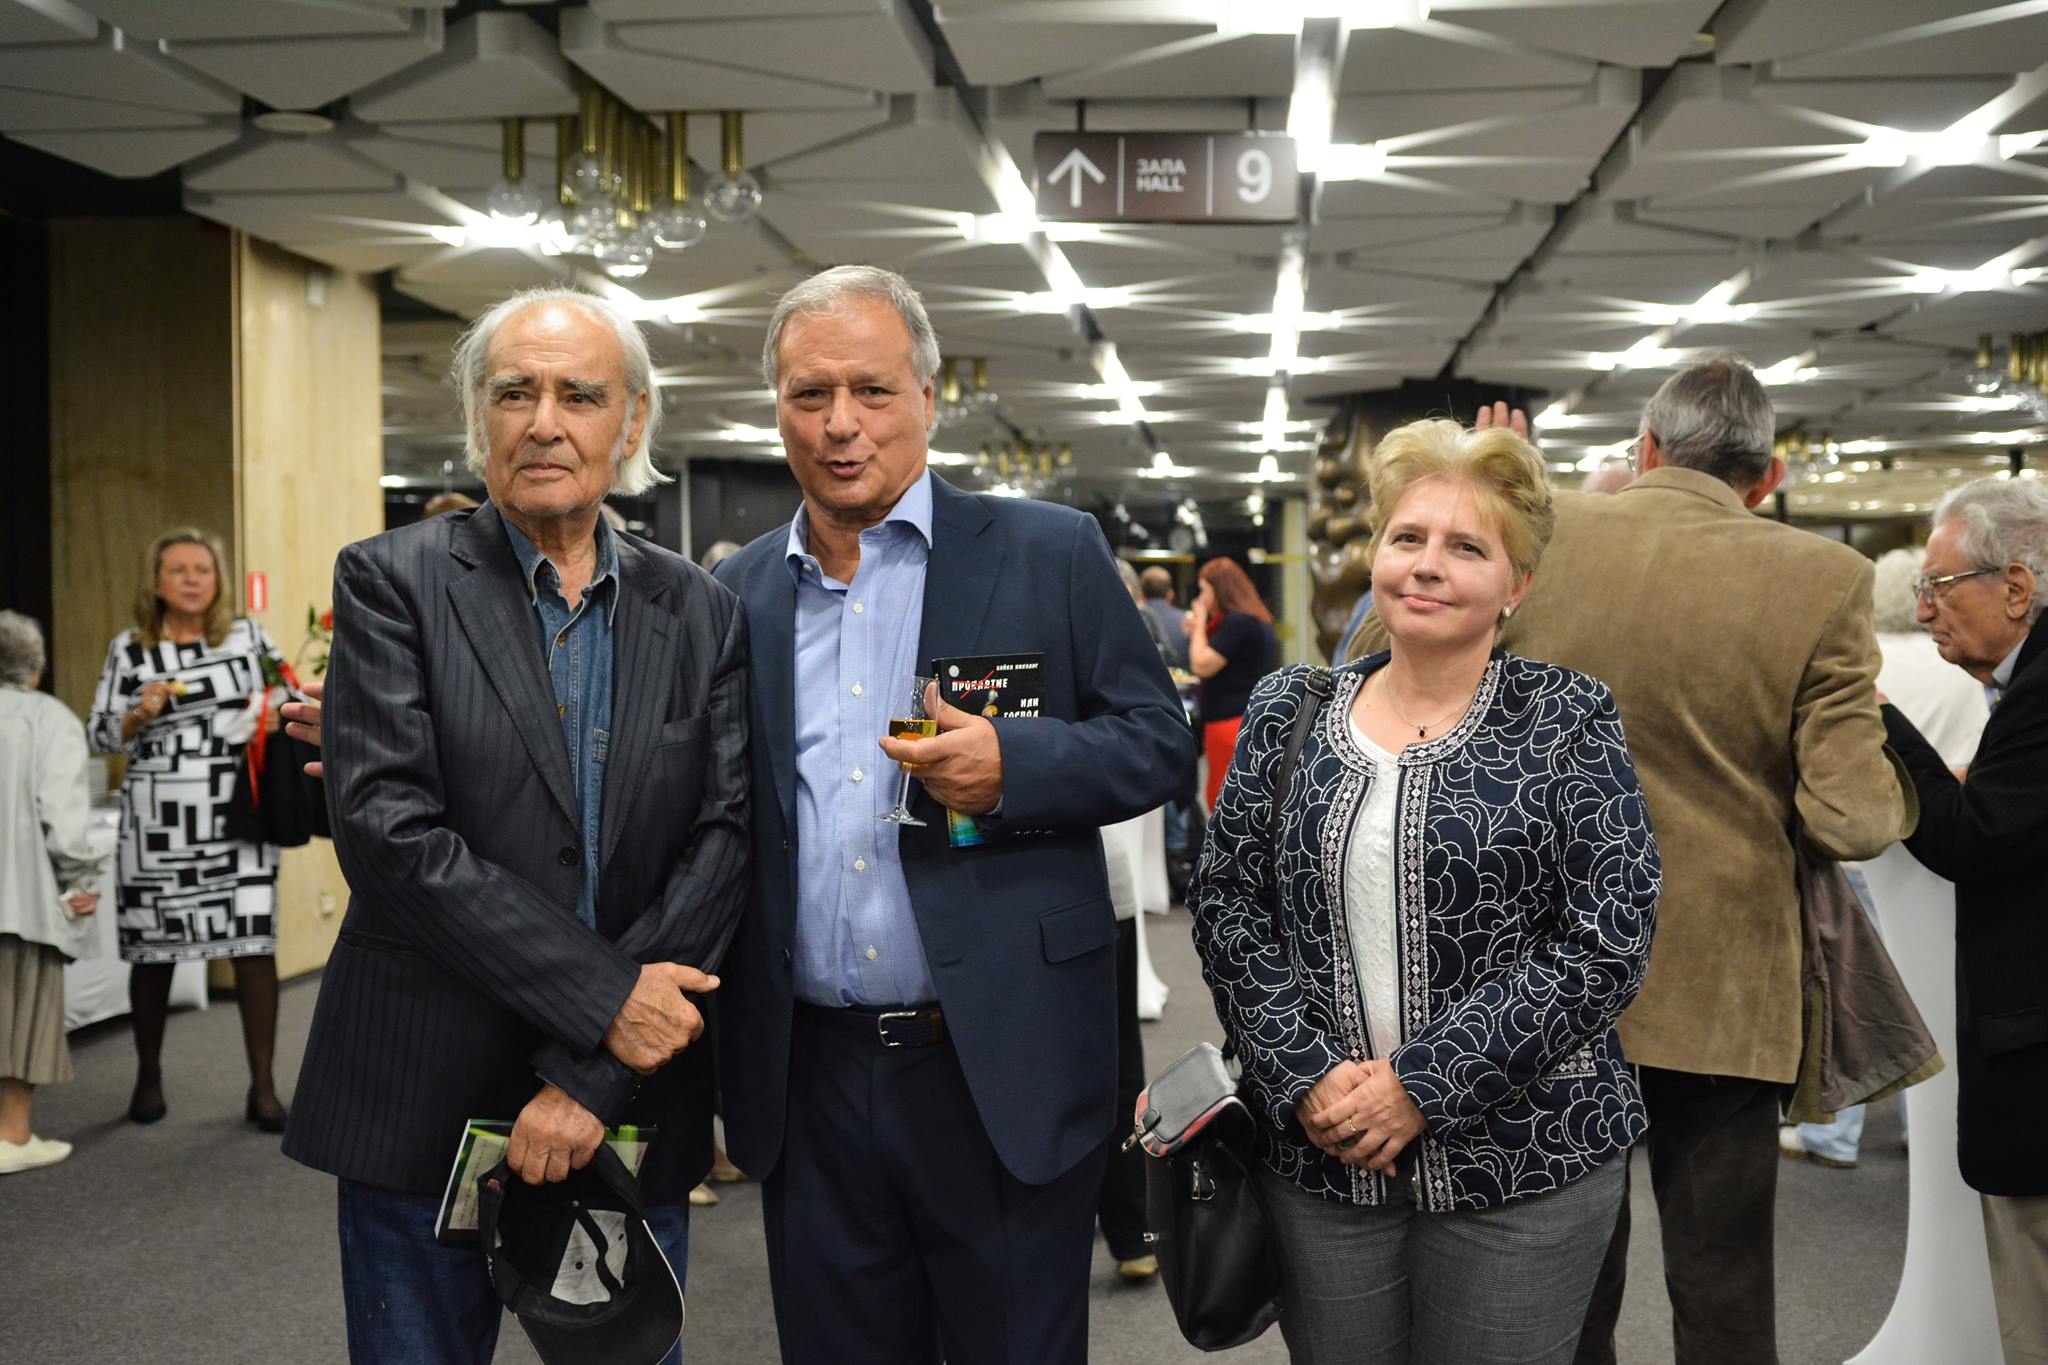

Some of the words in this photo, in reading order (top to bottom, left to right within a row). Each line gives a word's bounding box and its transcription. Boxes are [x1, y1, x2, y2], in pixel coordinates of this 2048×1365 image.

[1136, 158, 1186, 175] ЗАЛА
[1136, 175, 1184, 192] HALL
[1236, 149, 1273, 203] 9
[1020, 698, 1039, 708] ИЛИ
